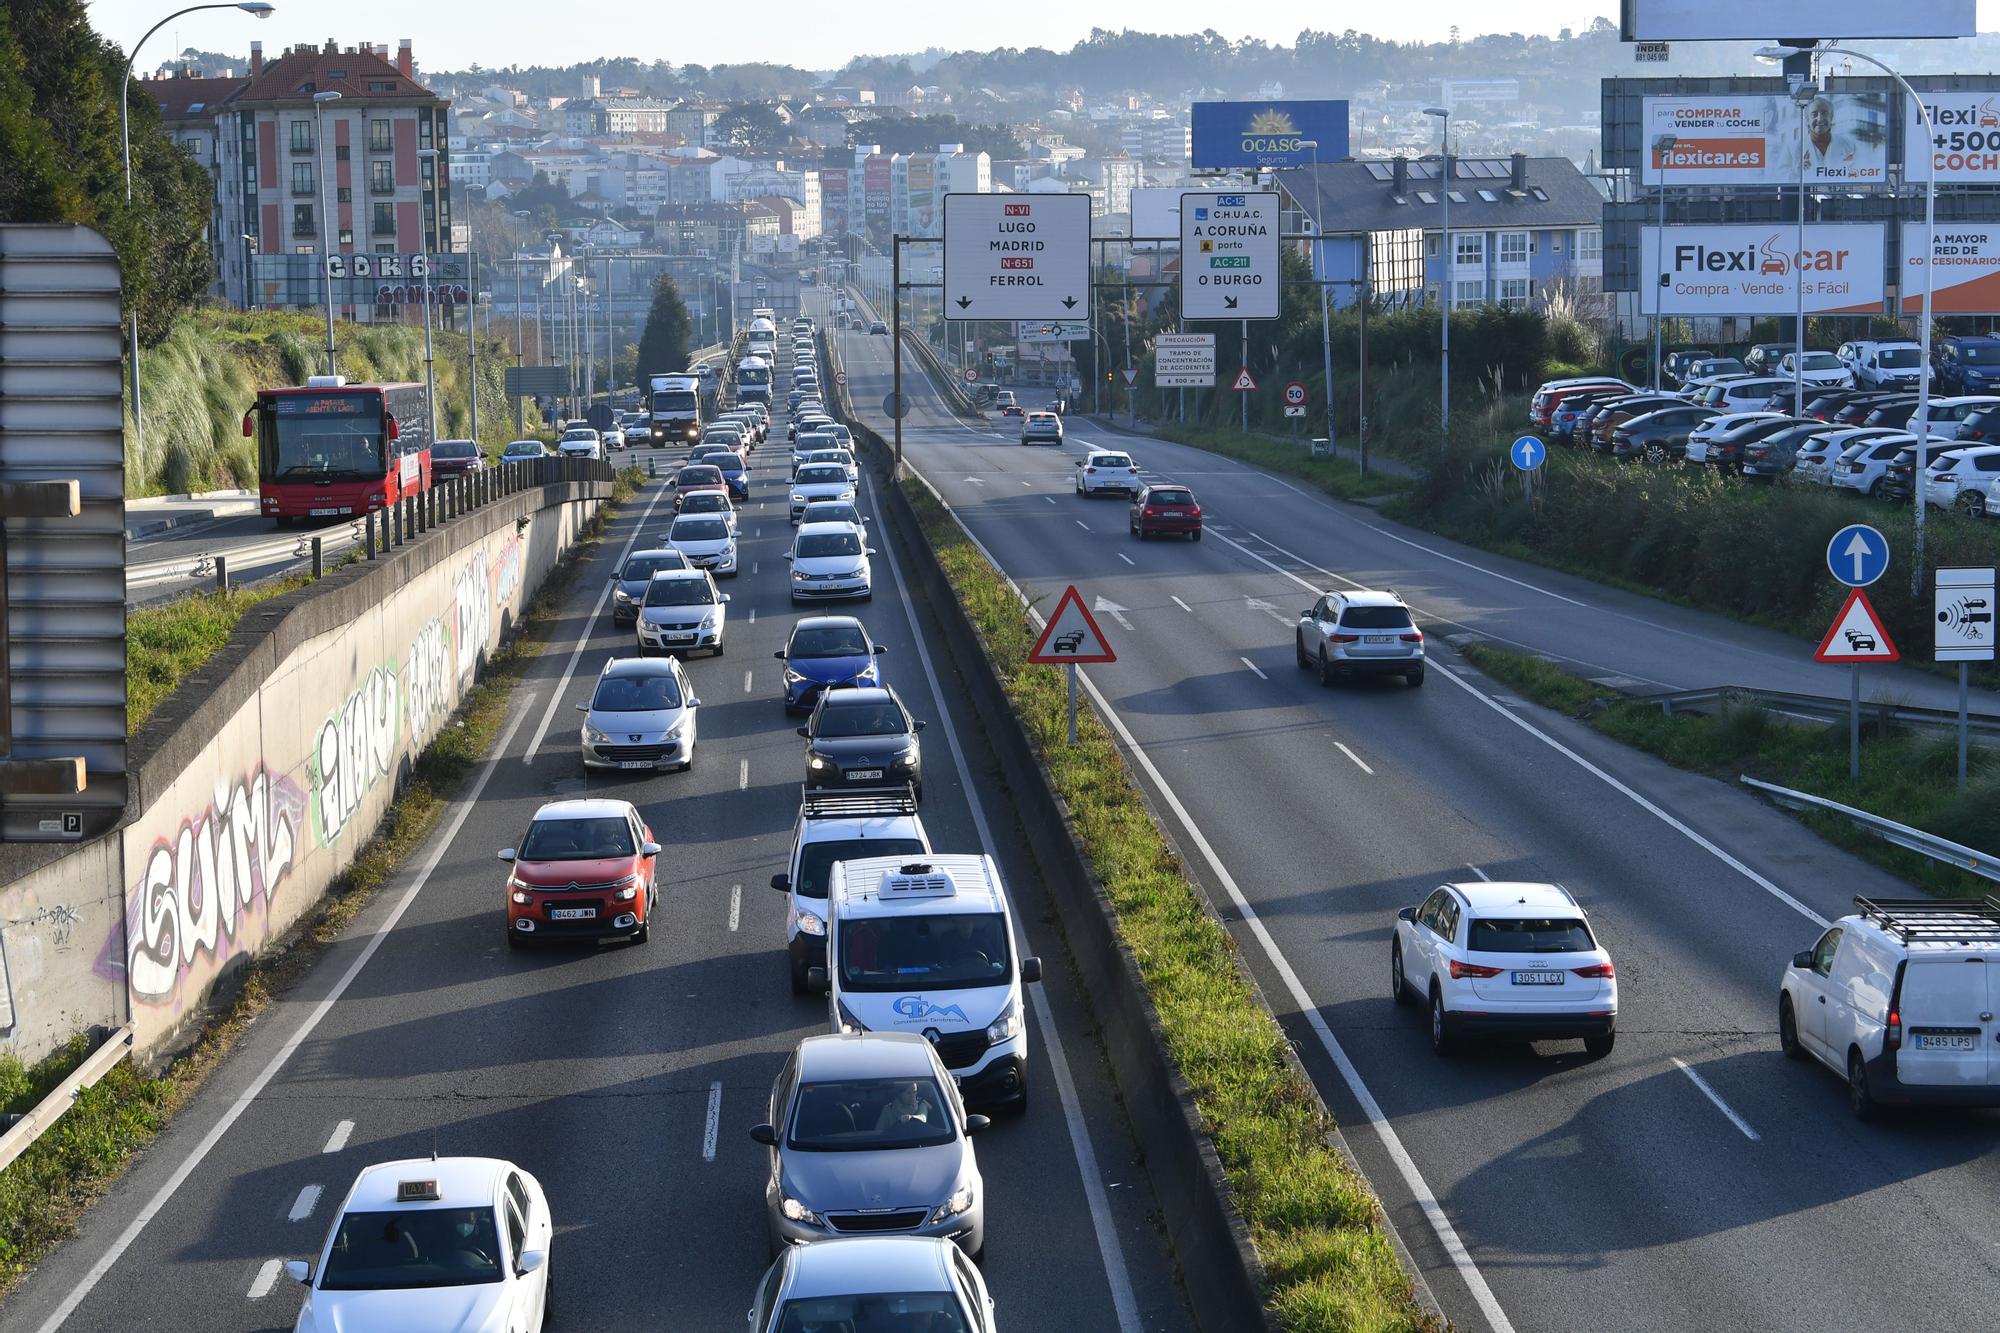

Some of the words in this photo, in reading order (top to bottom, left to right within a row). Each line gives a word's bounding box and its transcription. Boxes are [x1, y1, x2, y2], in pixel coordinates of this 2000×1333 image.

[1676, 109, 1741, 119] COMPRAR
[1674, 120, 1714, 128] VENDER
[1726, 119, 1761, 128] COCHE
[1242, 138, 1301, 152] OCASO
[1256, 154, 1287, 165] Seguros
[1662, 149, 1760, 166] flexicar.es
[1816, 166, 1846, 177] Flexi
[1860, 167, 1880, 176] car
[1218, 196, 1245, 205] AC-12
[1006, 206, 1029, 214] N-VI
[1213, 210, 1263, 219] C.H.U.A.C.
[998, 223, 1036, 232] LUGO
[1193, 226, 1202, 236] A
[1207, 223, 1267, 236] CORUÑA
[1944, 235, 1988, 243] MAYOR
[989, 241, 1045, 251] MADRID
[1217, 241, 1243, 250] porto
[1934, 246, 1959, 255] RED
[1962, 246, 1978, 255] DE
[1214, 257, 1247, 267] AC-211
[1675, 244, 1755, 272] Flexi
[1793, 250, 1849, 271] car
[1002, 259, 1033, 269] N-651
[990, 275, 1044, 286] FERROL
[1198, 275, 1208, 285] O
[1213, 274, 1262, 285] BURGO
[1675, 282, 1729, 297] Compra
[1741, 282, 1784, 294] Vende
[1818, 281, 1849, 294] Fácil
[966, 371, 977, 379] 50
[1288, 389, 1303, 400] 50
[557, 911, 577, 919] 3462
[1518, 973, 1540, 983] 3051
[1544, 973, 1562, 983] LCX
[1922, 1036, 1949, 1047] 9485
[1951, 1036, 1970, 1047] LPS
